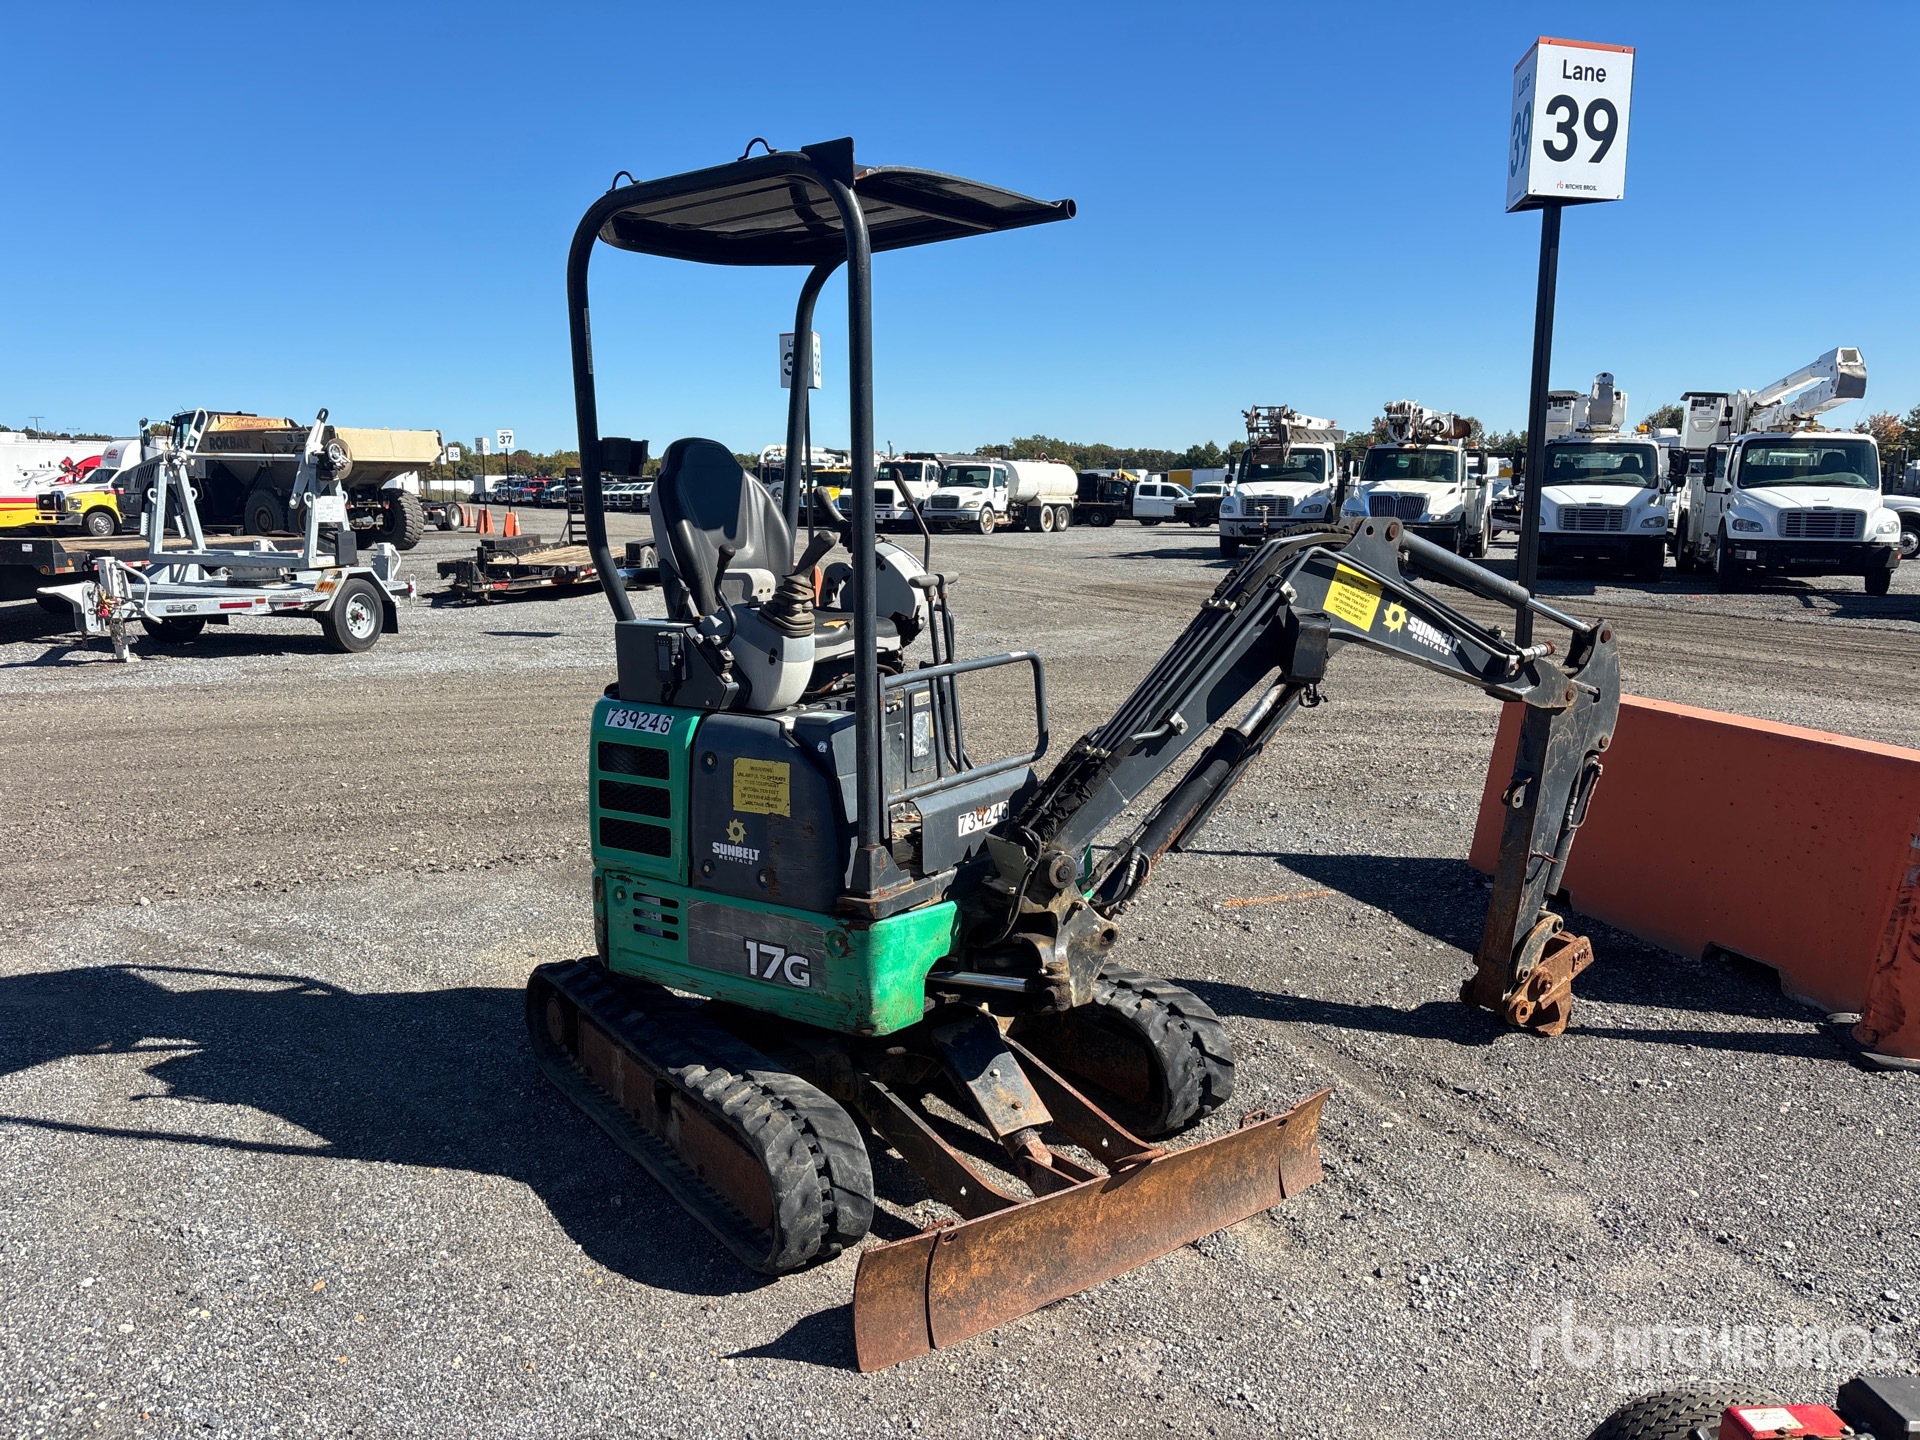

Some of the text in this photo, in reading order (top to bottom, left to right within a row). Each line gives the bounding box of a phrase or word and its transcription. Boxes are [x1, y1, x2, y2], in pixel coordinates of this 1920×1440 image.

[1562, 59, 1606, 83] Lane
[1510, 101, 1532, 178] 39
[1543, 94, 1618, 163] 39
[209, 436, 252, 450] ROKBAK
[499, 435, 512, 444] 37
[1407, 616, 1461, 653] SUNBELT
[1412, 634, 1450, 656] RENTALS
[607, 708, 673, 734] 739246
[712, 842, 760, 861] SUNBELT
[719, 854, 753, 865] RENTALS
[745, 940, 811, 987] 17G
